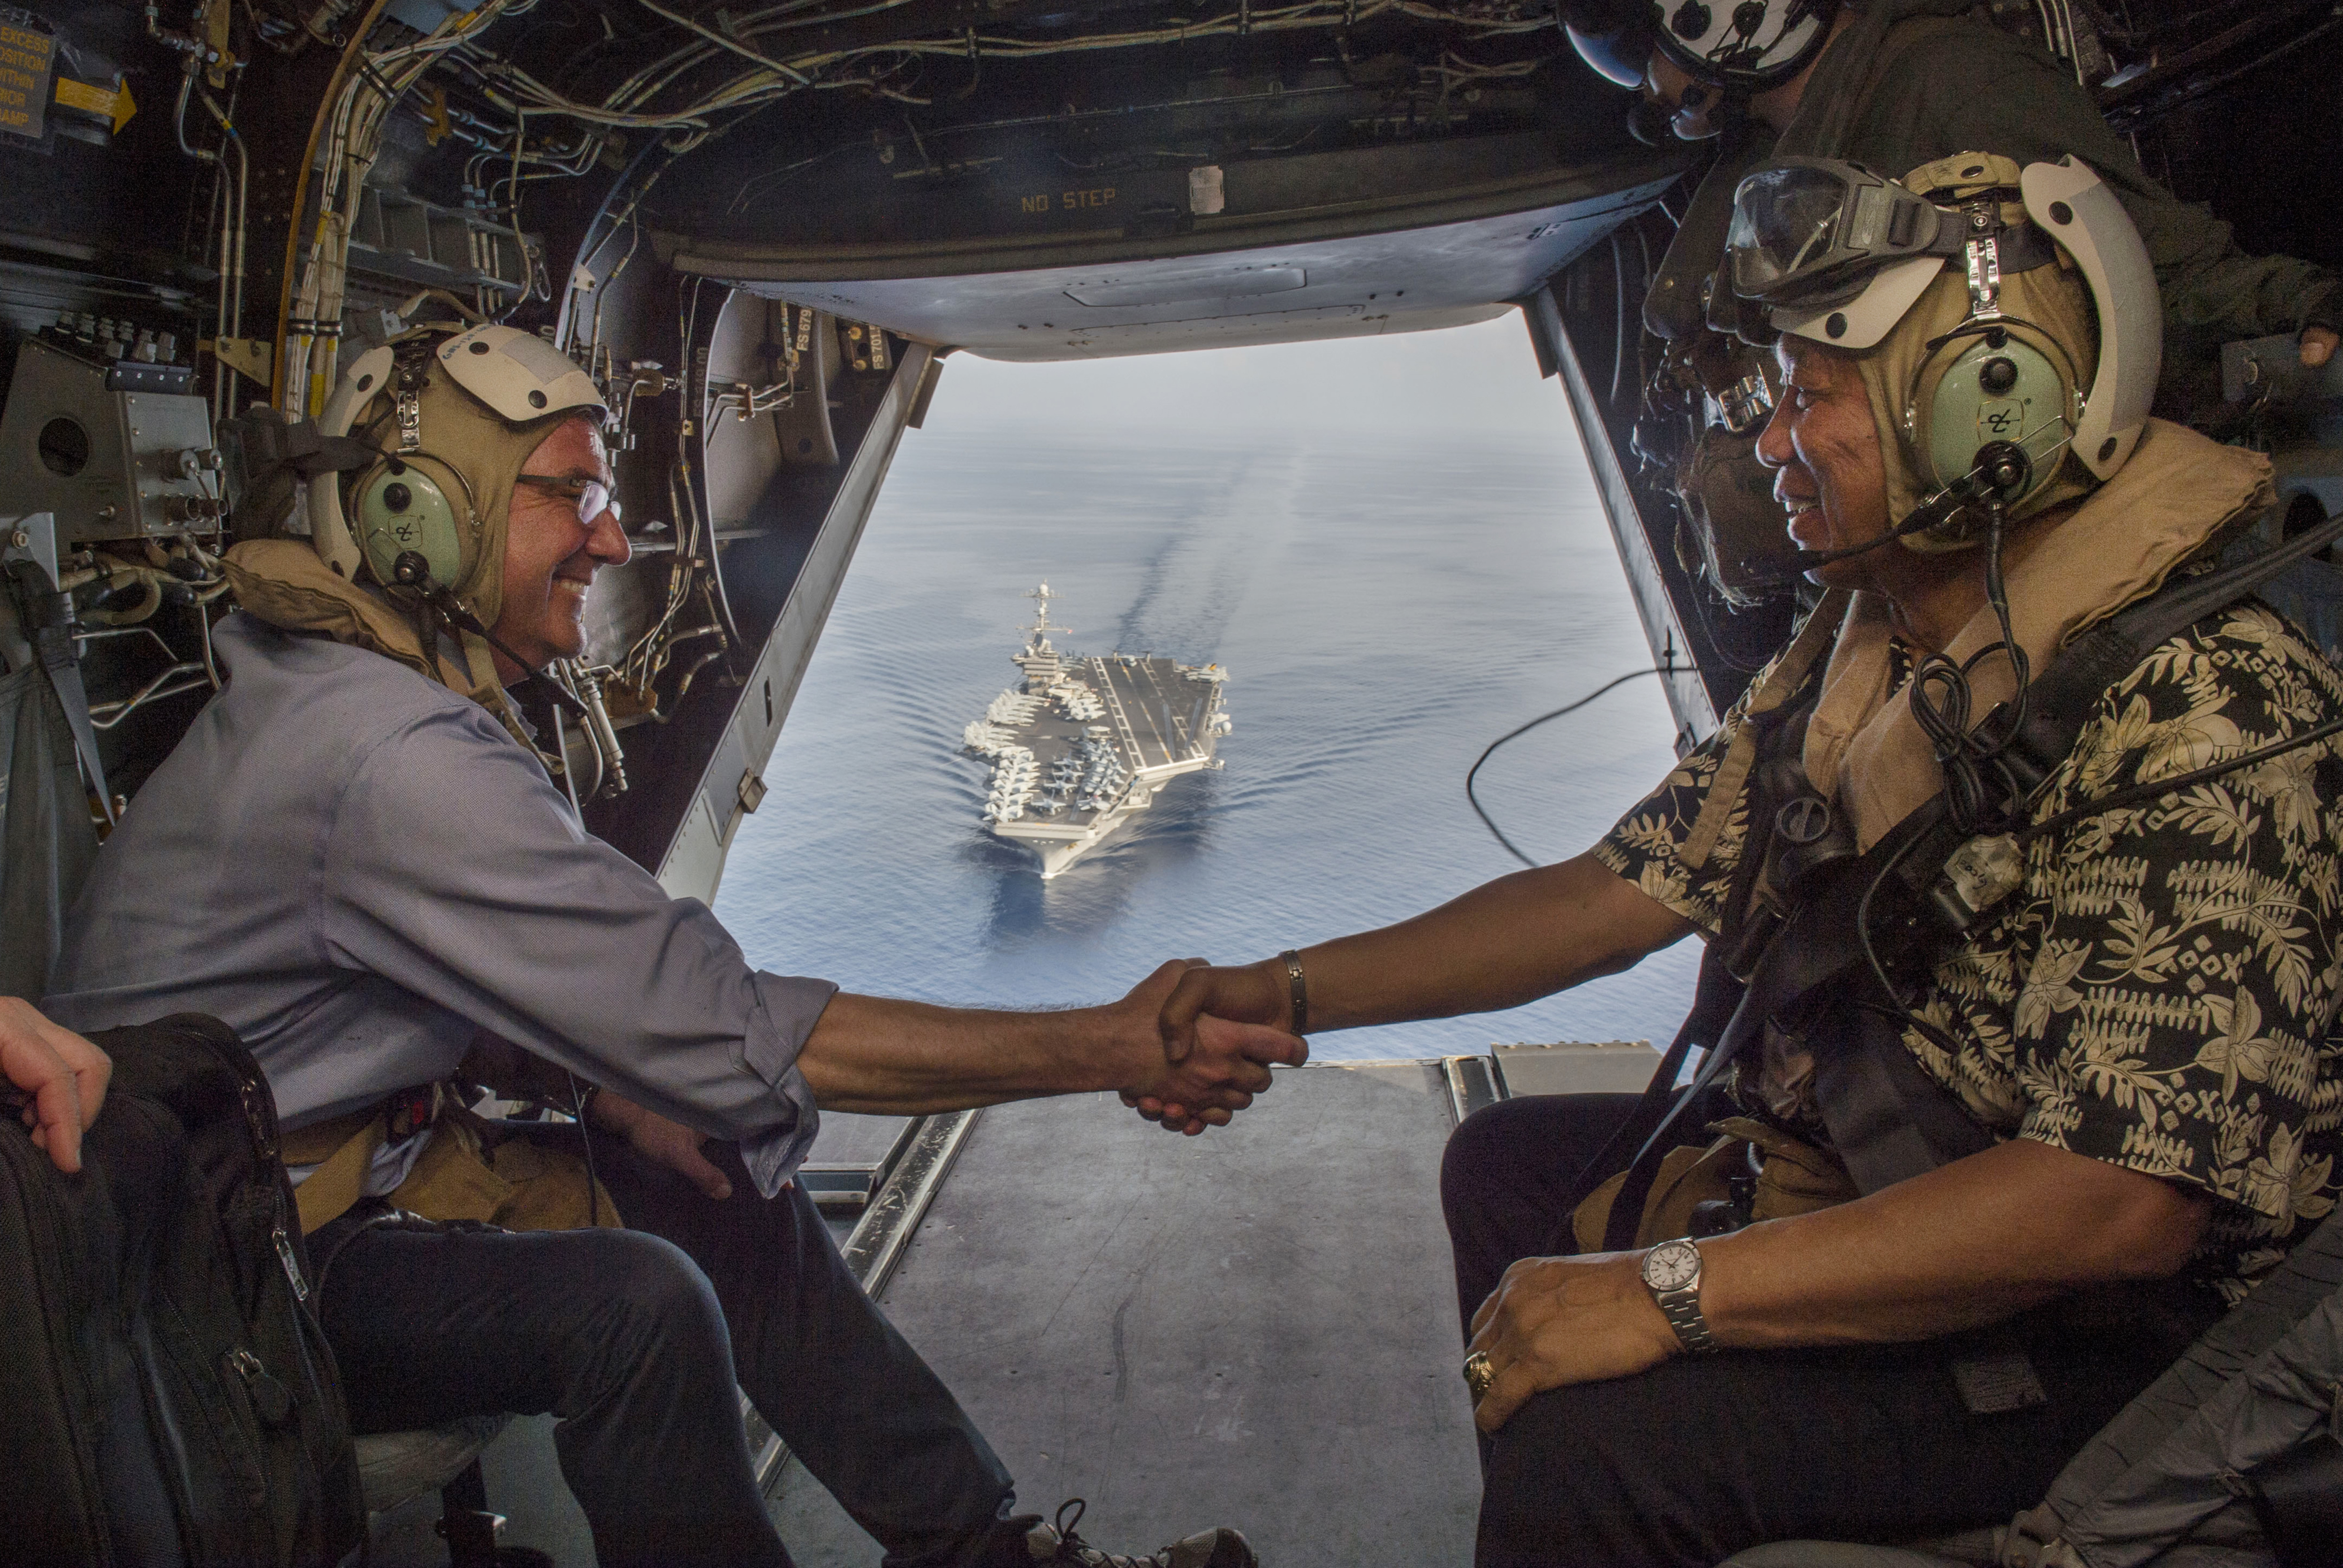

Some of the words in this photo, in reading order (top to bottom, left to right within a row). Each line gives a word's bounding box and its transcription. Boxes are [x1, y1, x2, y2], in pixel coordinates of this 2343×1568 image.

[0, 26, 49, 54] EXCESS
[0, 108, 29, 127] AMP
[1022, 194, 1049, 213] NO
[1063, 188, 1115, 209] STEP
[798, 309, 813, 331] 679
[796, 334, 809, 351] FS
[872, 355, 884, 370] FS
